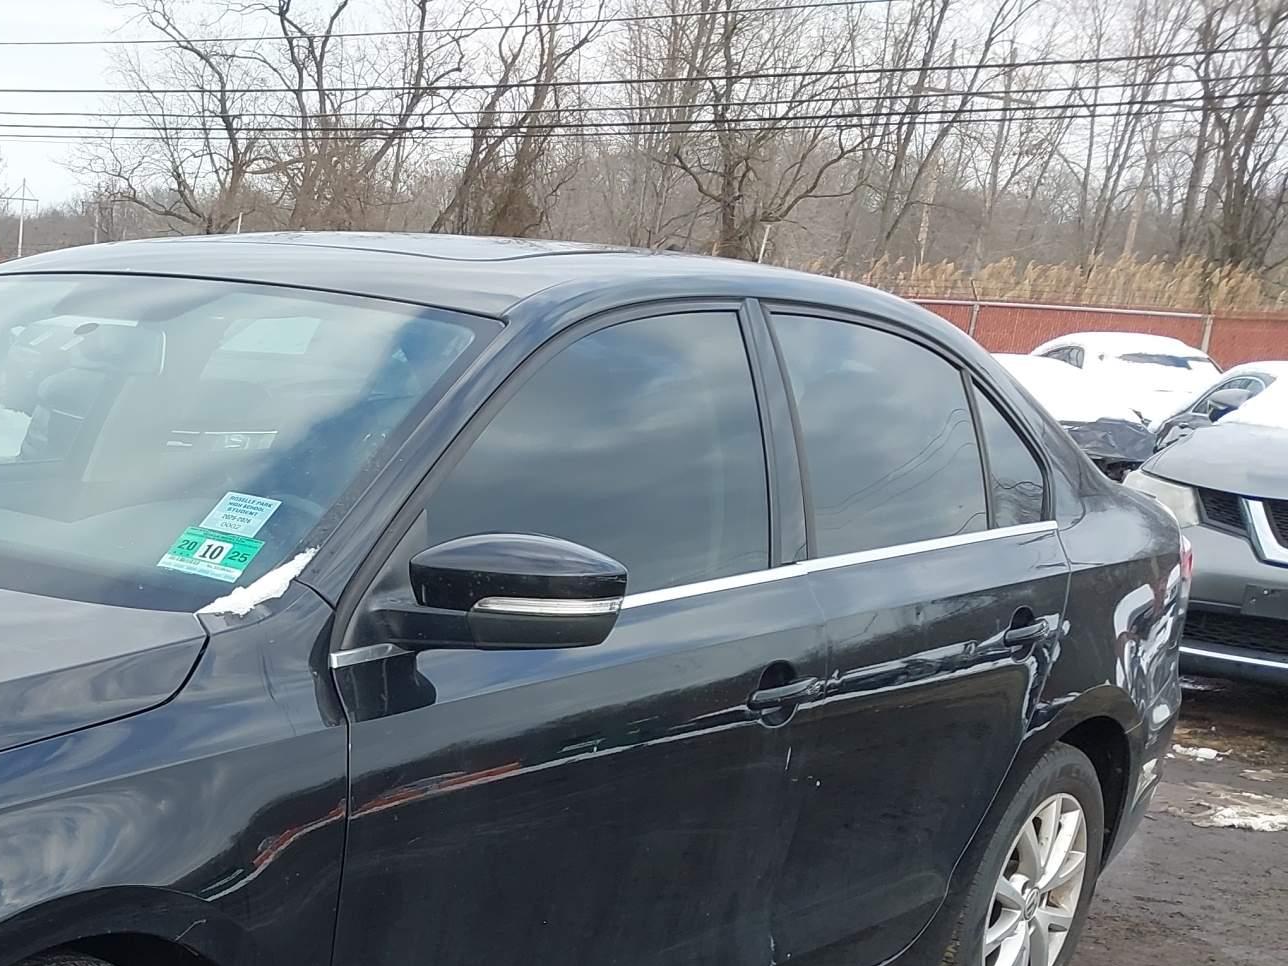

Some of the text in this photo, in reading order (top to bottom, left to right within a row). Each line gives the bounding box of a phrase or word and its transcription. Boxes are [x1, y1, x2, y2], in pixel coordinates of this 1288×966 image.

[177, 539, 251, 563] 20 10 25
